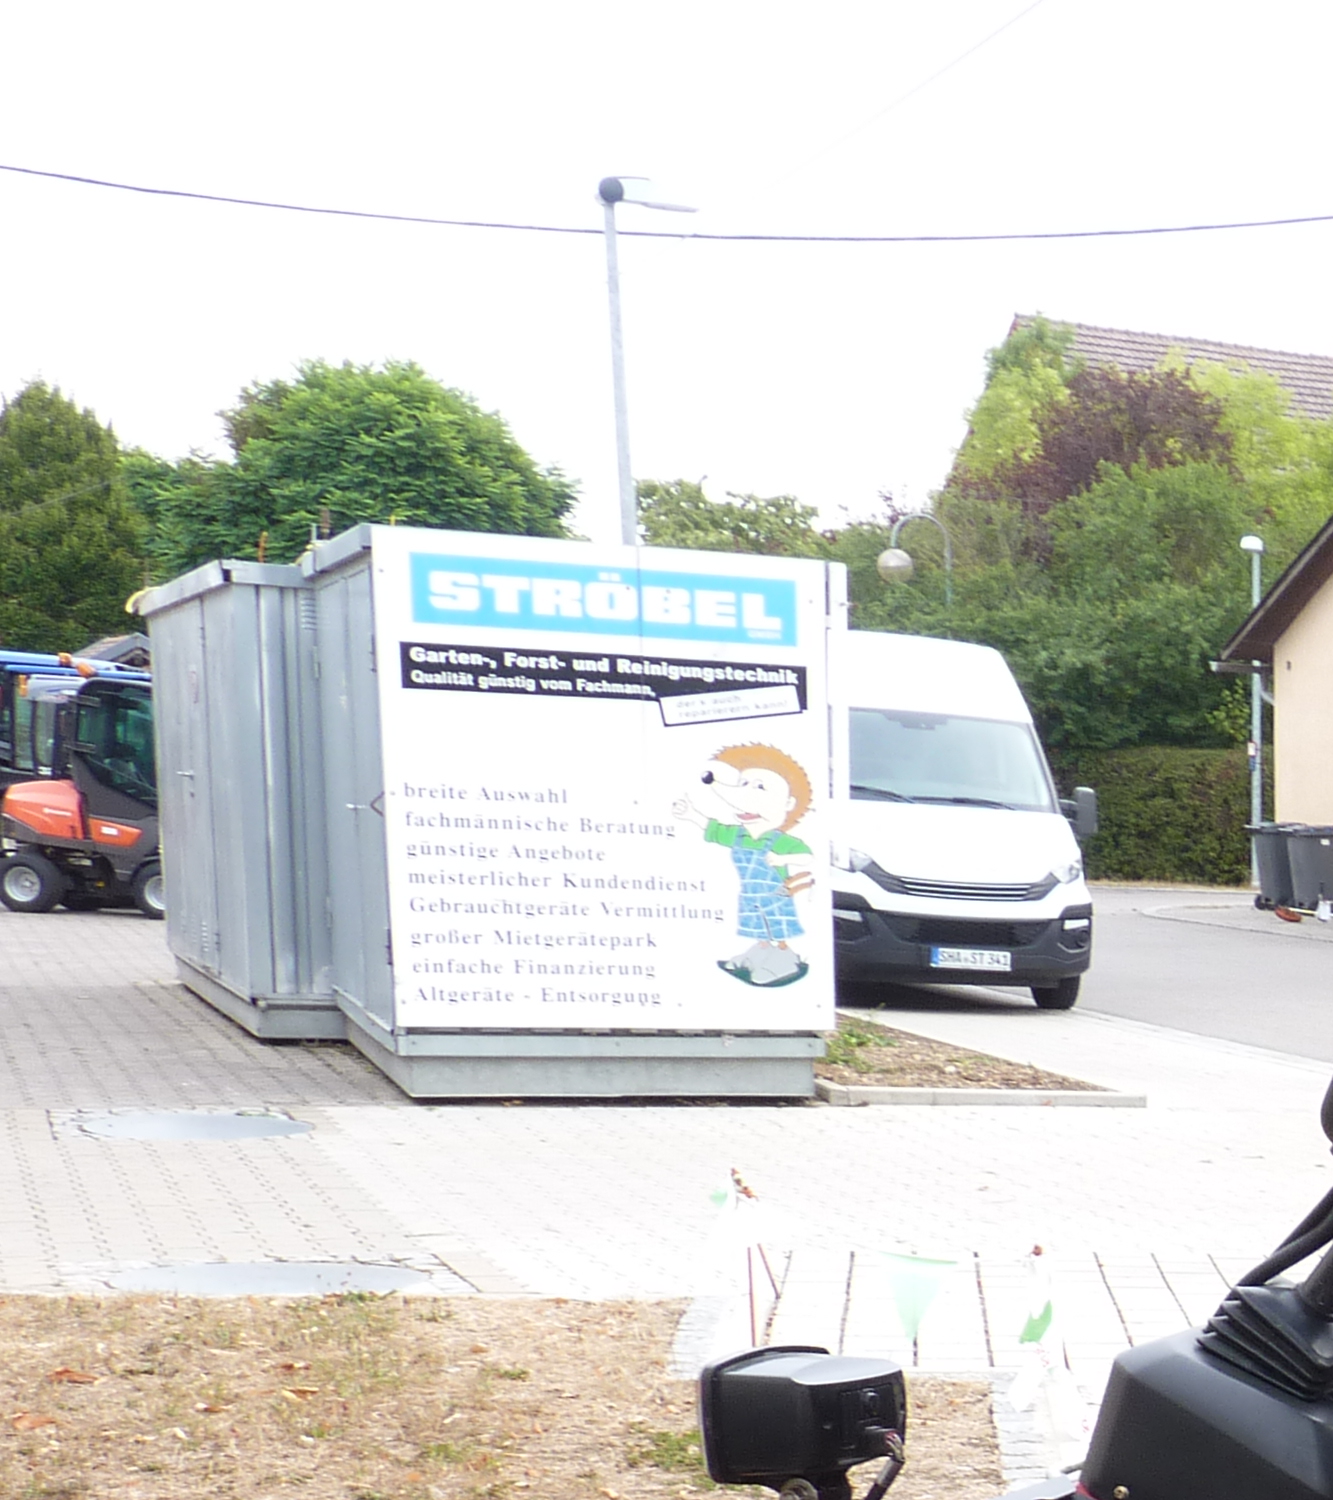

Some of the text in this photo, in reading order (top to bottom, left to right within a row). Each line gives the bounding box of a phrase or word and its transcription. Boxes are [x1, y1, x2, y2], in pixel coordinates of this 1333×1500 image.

[428, 570, 782, 630] STRÖBEL
[409, 646, 799, 685] Garten-, Forst- und Reinigungstechnik
[410, 669, 656, 697] Qualität günstig vom Fachmann,
[403, 782, 568, 804] breite Auswahl
[405, 811, 676, 838] fachmännische Beratung
[406, 841, 606, 864] günstige Angebote
[408, 870, 707, 893] meisterlicher Kundendienst
[410, 897, 725, 922] Gebrauchtgeräte Vermittlung
[411, 930, 658, 951] großer Mietgerätepark
[412, 958, 655, 980] einfache Finanzierung
[416, 986, 515, 1006] Altgeräte
[541, 987, 662, 1007] Entsorgung
